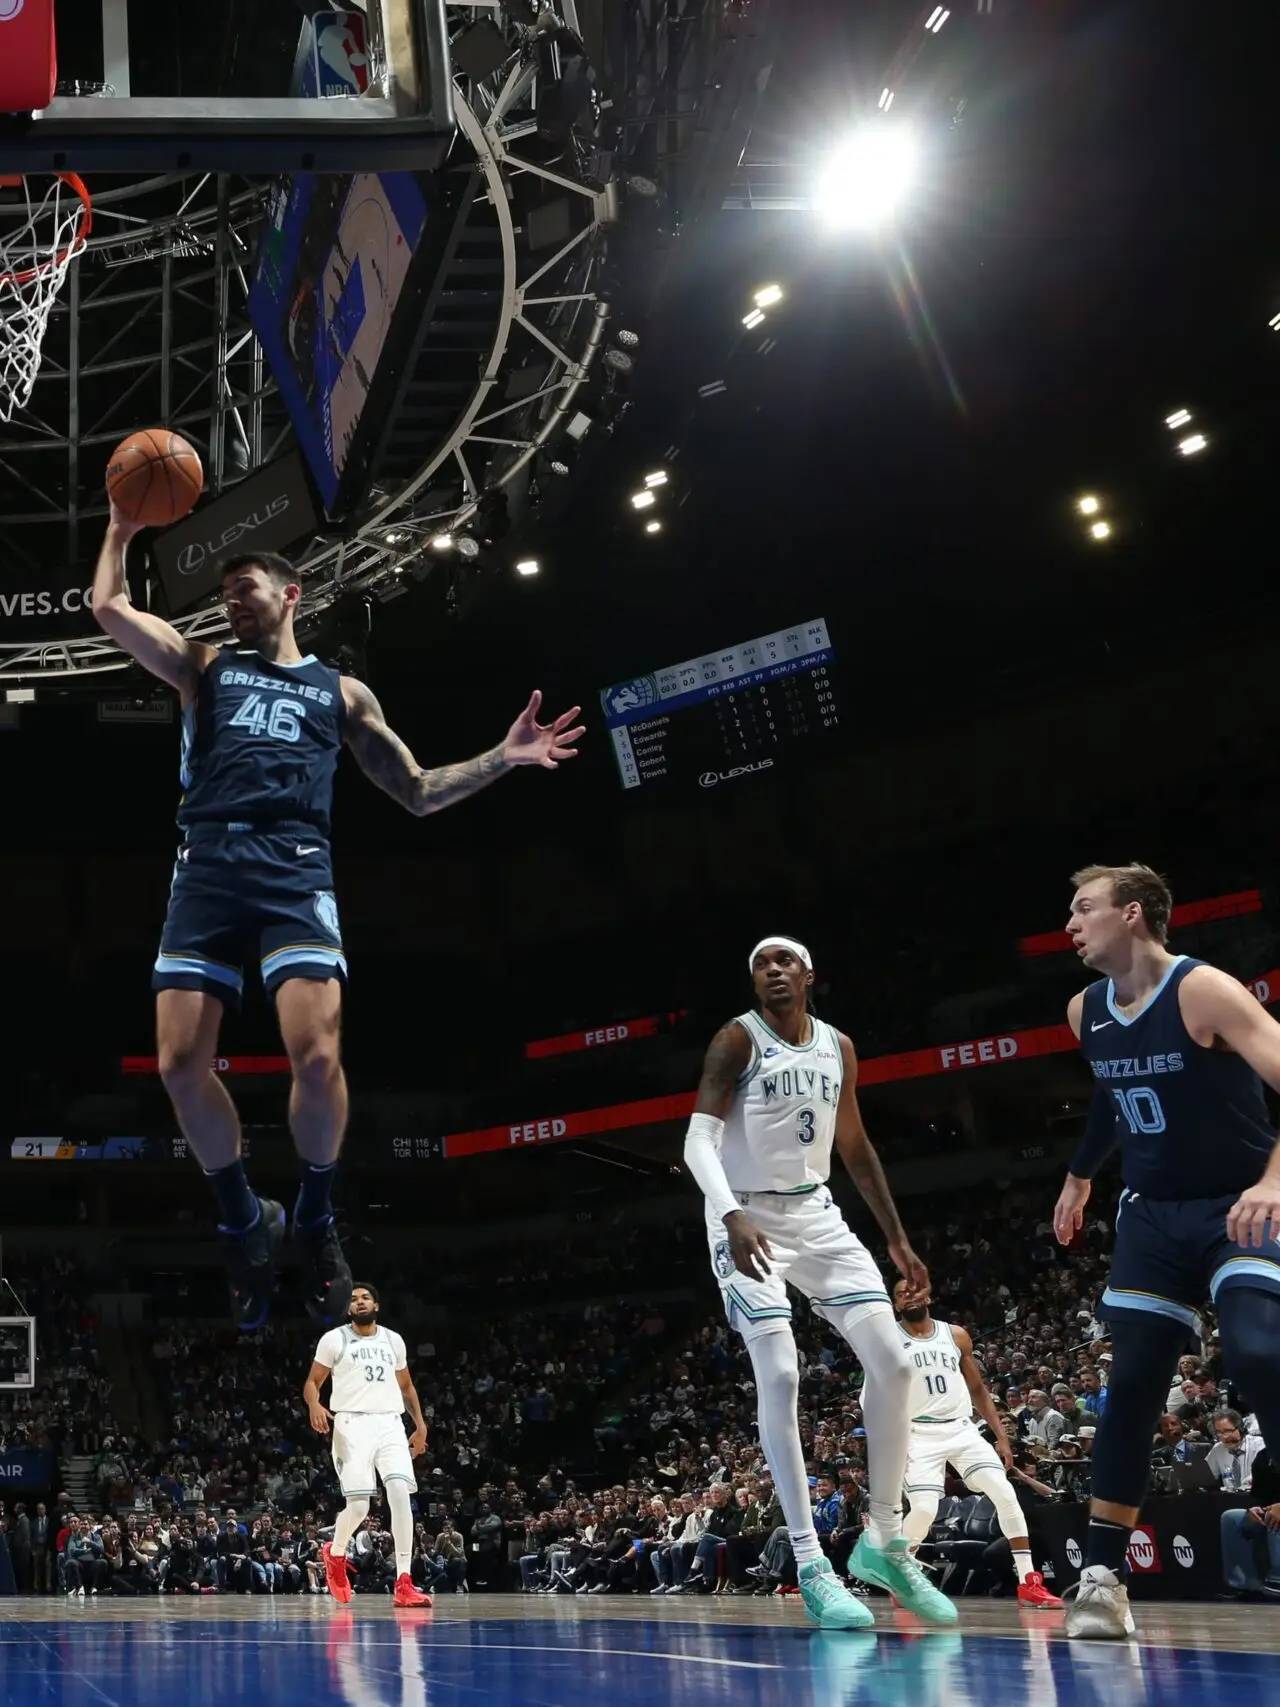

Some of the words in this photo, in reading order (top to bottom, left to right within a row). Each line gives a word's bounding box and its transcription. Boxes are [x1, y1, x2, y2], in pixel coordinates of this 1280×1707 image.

[208, 494, 290, 554] LEXUS
[220, 670, 333, 706] GRIZZLIES
[228, 693, 306, 743] 46
[630, 716, 671, 733] McDaniels
[633, 730, 668, 745] Edwards
[636, 743, 663, 756] Conley
[639, 755, 666, 768] Gobert
[719, 758, 773, 780] LEXUS
[642, 767, 668, 779] Towns
[585, 1025, 628, 1046] FEED
[940, 1037, 1018, 1068] FEED
[762, 1068, 840, 1109] WOLVES
[1111, 1086, 1168, 1135] 10
[509, 1119, 567, 1144] FEED
[798, 1109, 816, 1145] 3
[25, 1142, 43, 1156] 21
[392, 1138, 411, 1148] CHI
[393, 1149, 411, 1158] TOR
[351, 1347, 394, 1366] WOLVES
[914, 1350, 957, 1372] OLVES
[365, 1365, 385, 1382] 32
[925, 1374, 947, 1395] 10
